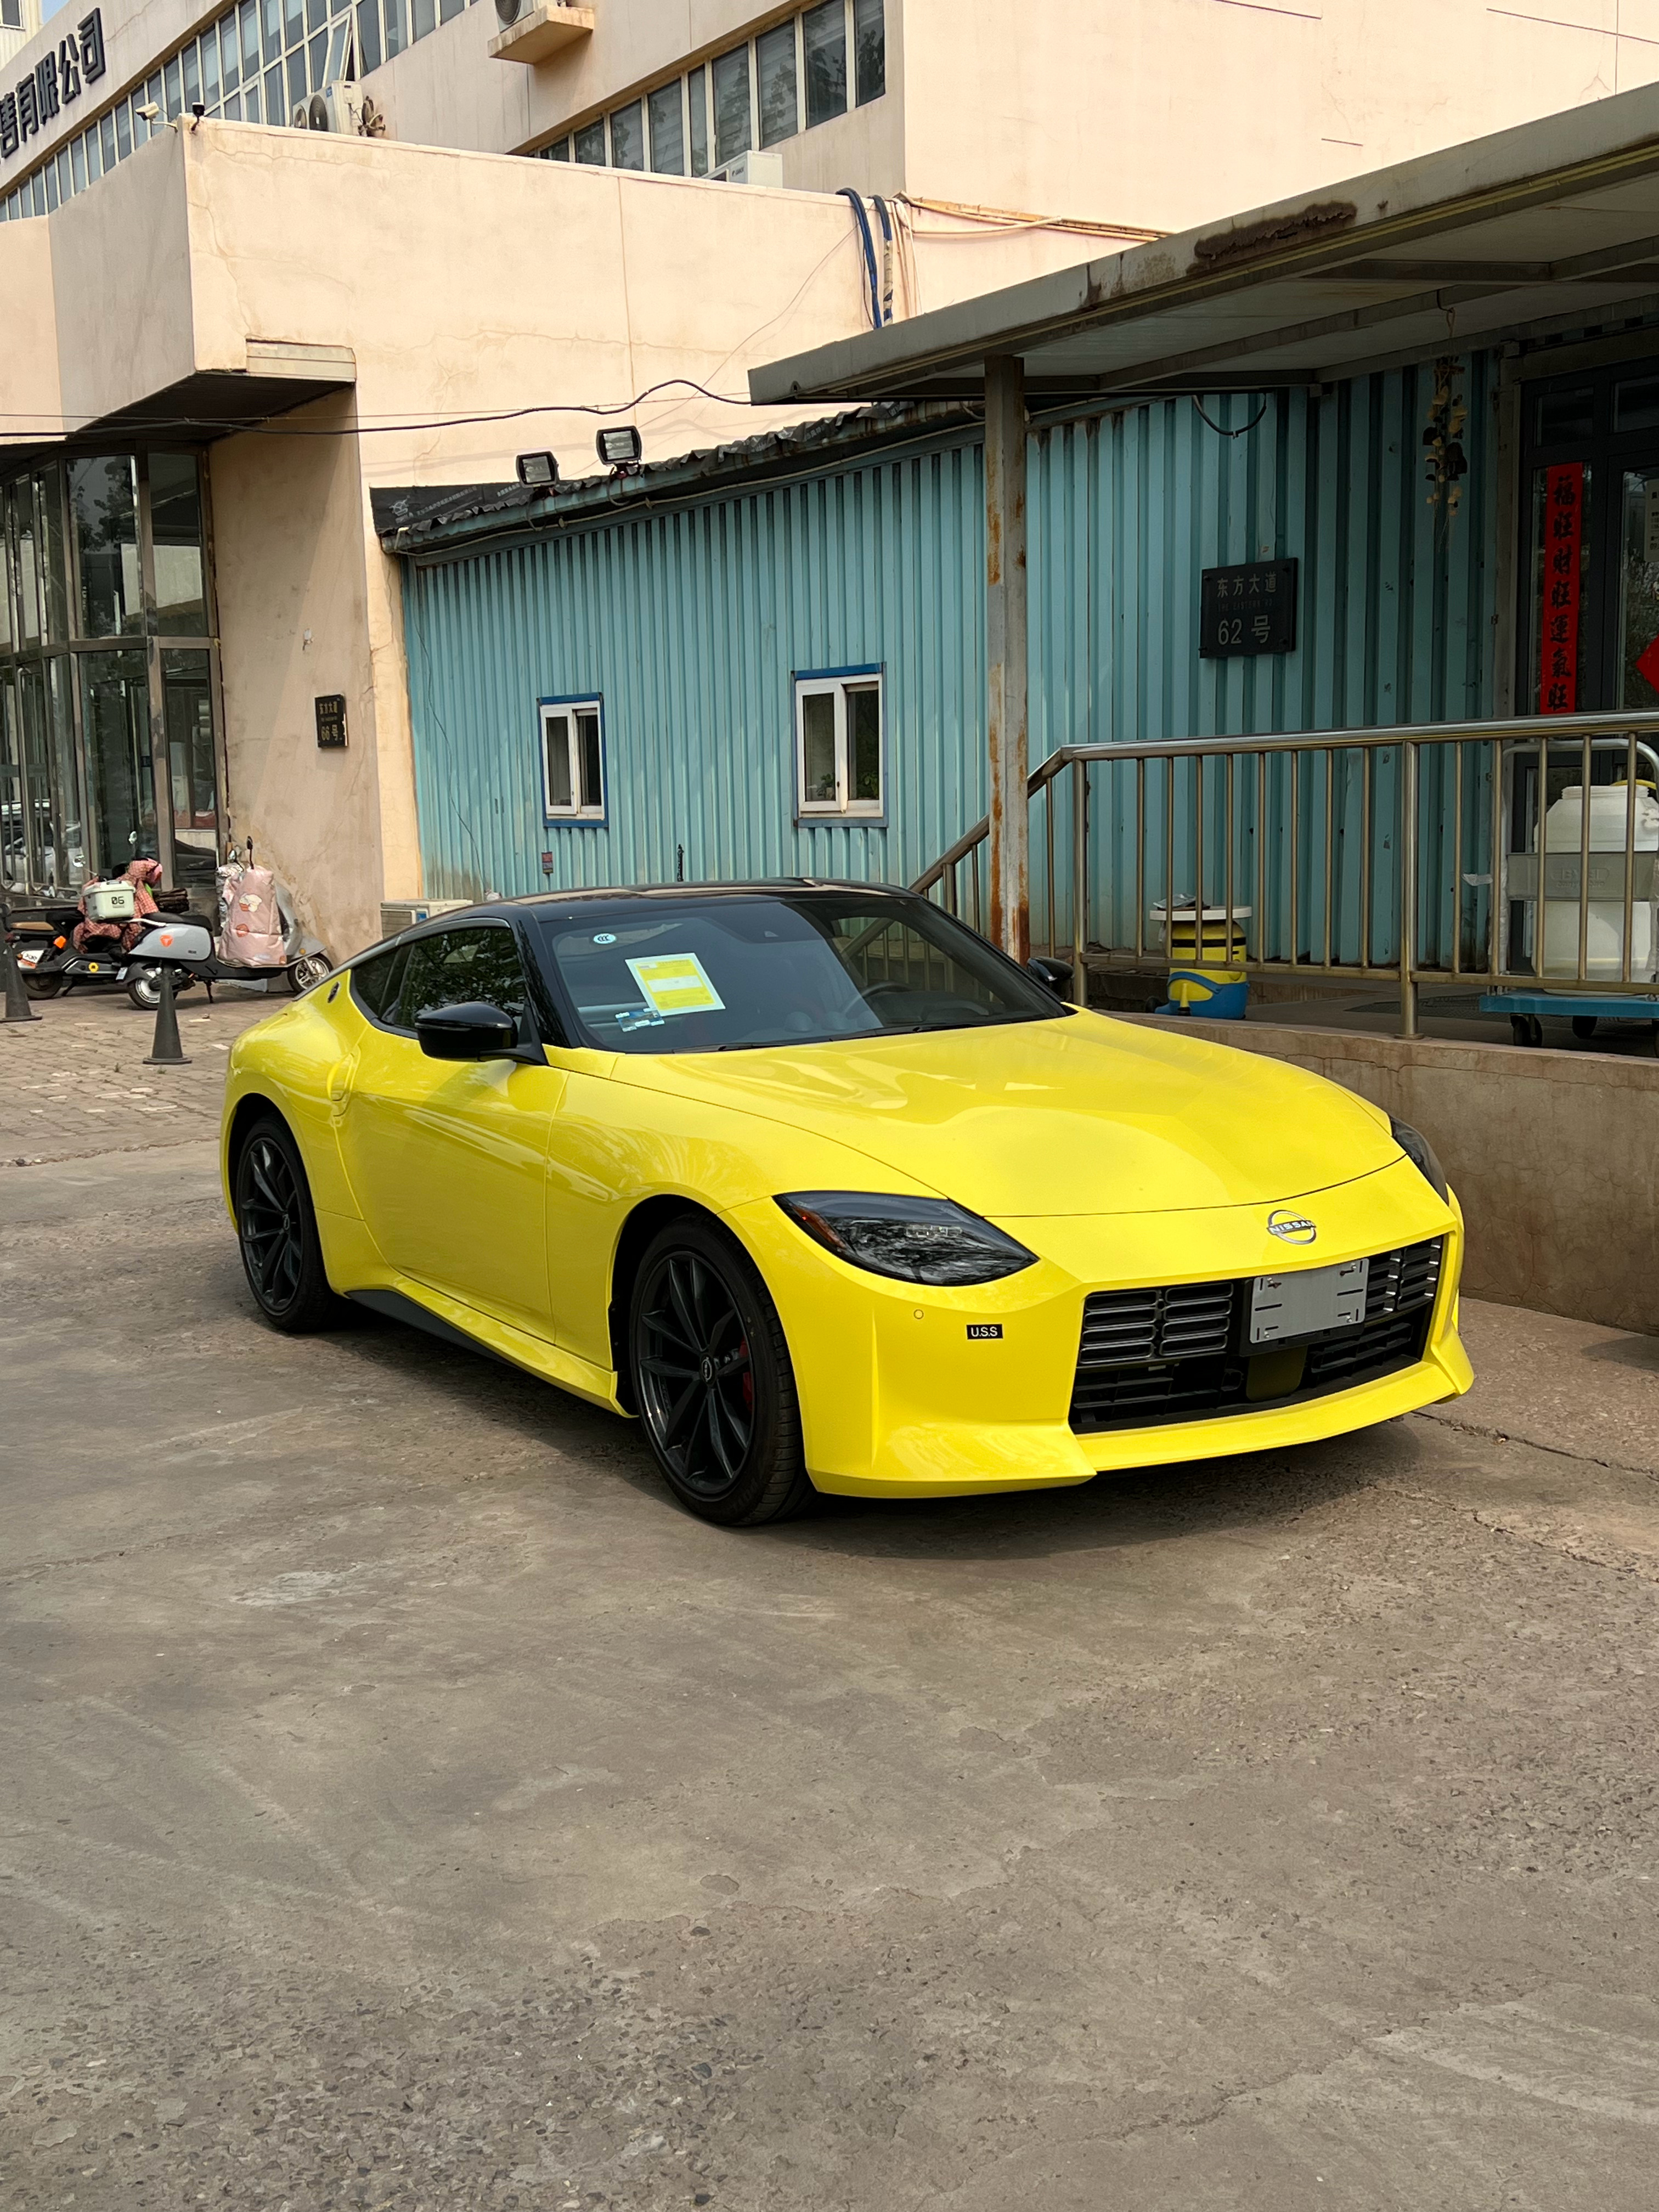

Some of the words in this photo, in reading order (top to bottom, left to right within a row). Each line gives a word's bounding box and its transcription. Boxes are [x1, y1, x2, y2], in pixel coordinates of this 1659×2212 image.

[0, 8, 105, 158] 售有限公司
[1217, 571, 1277, 598] 东方大道
[970, 1326, 998, 1337] U.S.S
